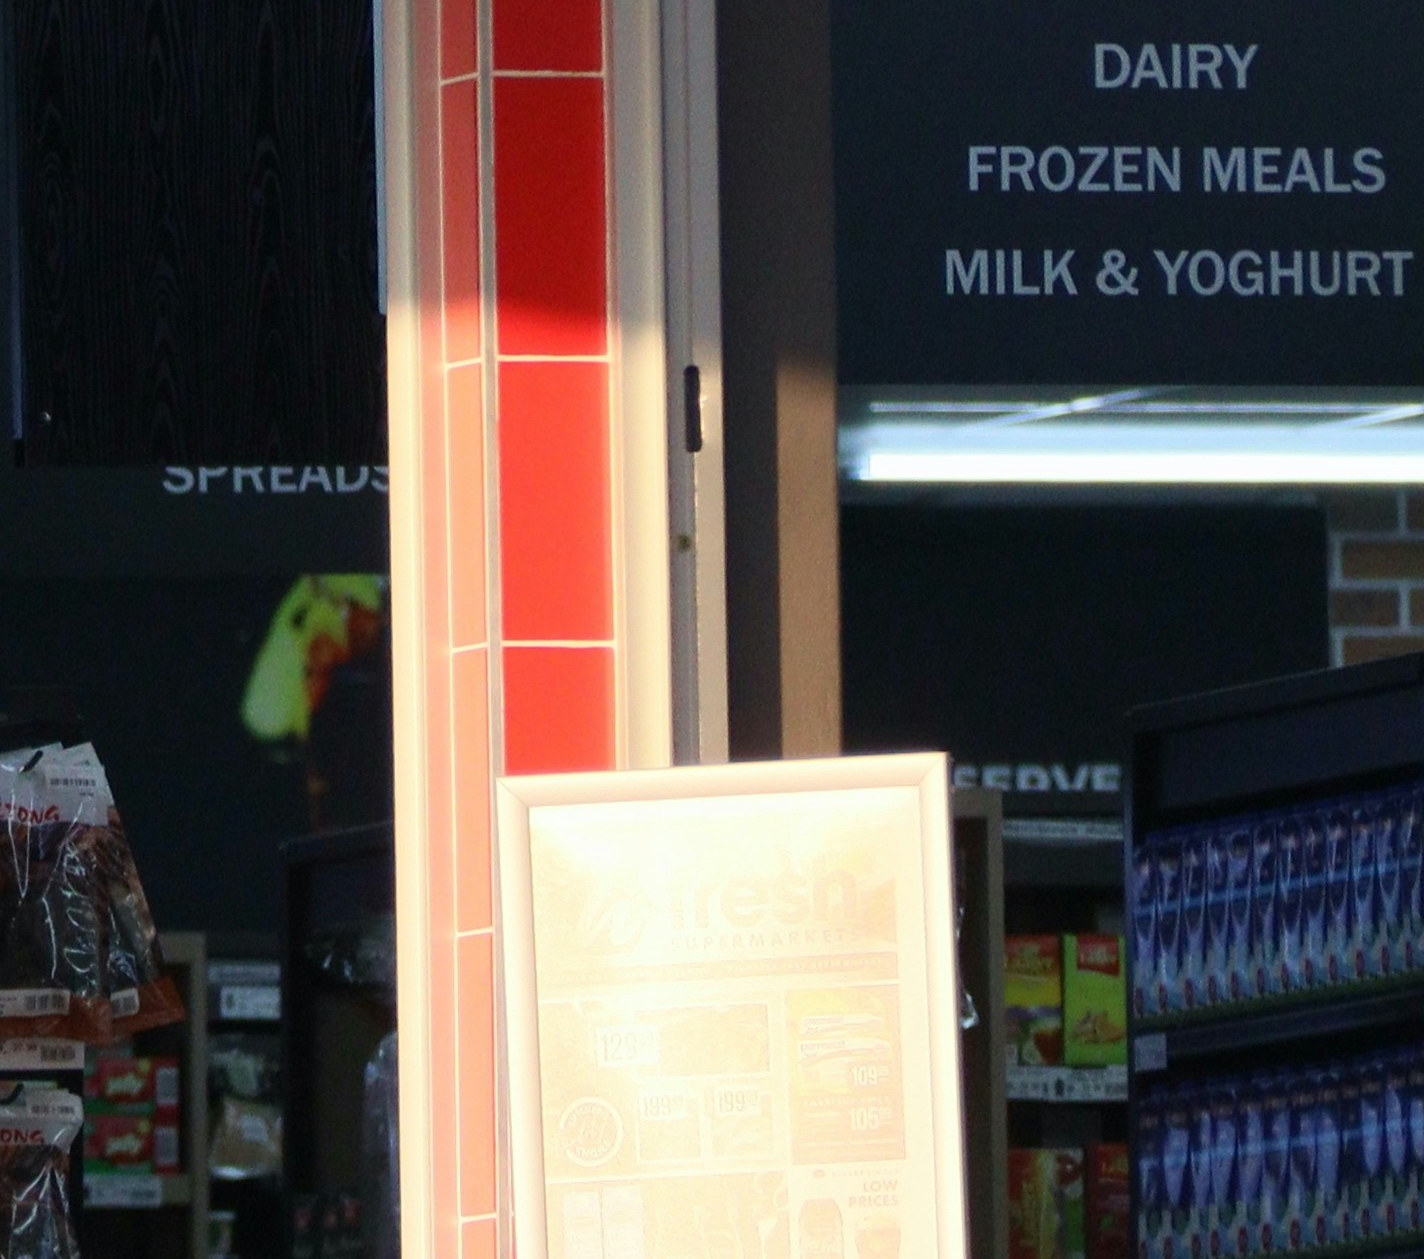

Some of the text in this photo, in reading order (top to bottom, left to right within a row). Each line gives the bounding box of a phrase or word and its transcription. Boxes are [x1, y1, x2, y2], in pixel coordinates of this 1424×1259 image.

[1094, 43, 1259, 89] DAIRY
[967, 145, 1387, 194] FROZEN MEALS
[945, 248, 1413, 297] MILK & YOGHURT
[849, 1194, 899, 1208] PRICES
[863, 1179, 899, 1193] LOW
